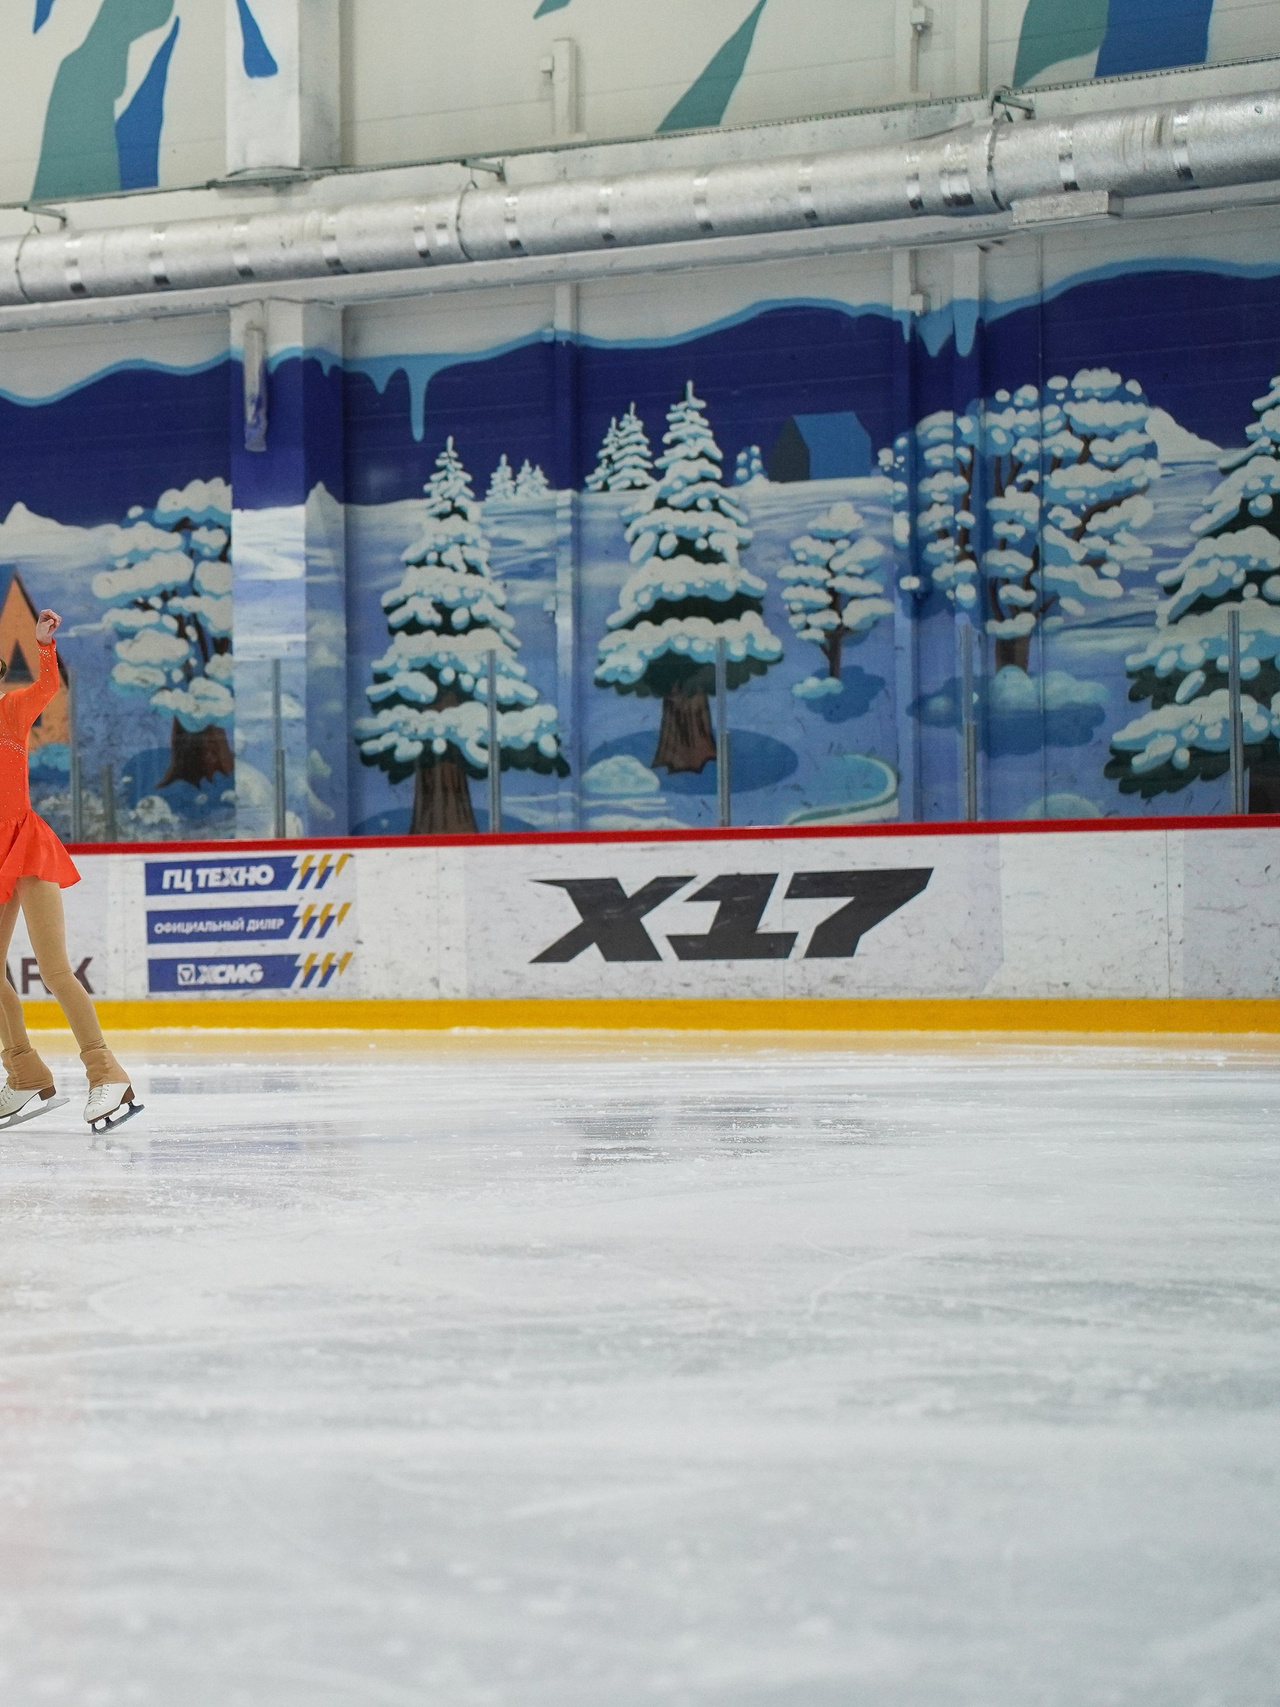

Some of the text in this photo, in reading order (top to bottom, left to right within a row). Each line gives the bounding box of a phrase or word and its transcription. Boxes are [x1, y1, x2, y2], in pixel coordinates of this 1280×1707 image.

[196, 864, 275, 888] ТЕХНО
[154, 917, 285, 935] ОФИЦИАЛЬНЫЙ ДИЛЕР
[529, 867, 935, 963] X17
[196, 963, 264, 985] XCMG
